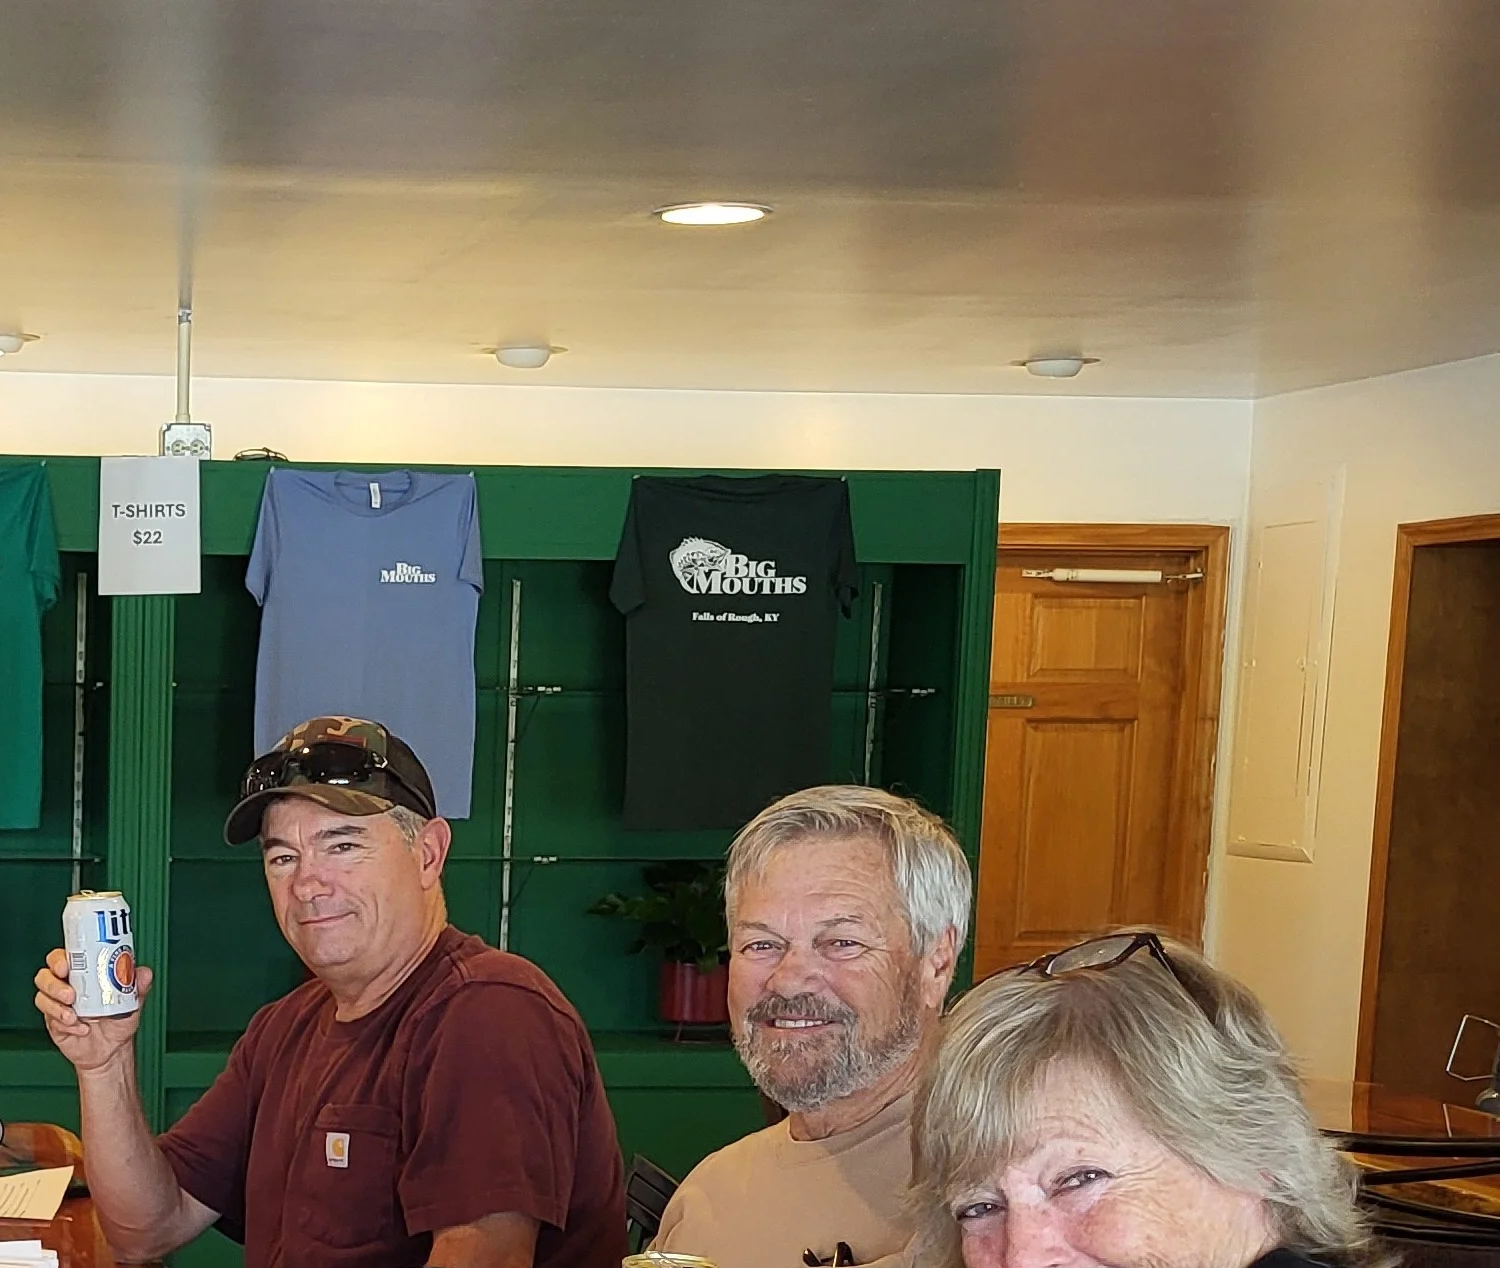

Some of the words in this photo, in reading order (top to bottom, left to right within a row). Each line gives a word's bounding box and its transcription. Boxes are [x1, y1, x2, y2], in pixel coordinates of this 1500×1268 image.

[111, 503, 186, 519] T-SHIRTS
[132, 529, 163, 546] $22
[691, 611, 715, 622] Falls
[716, 612, 728, 622] of
[727, 612, 763, 624] Rough,
[764, 613, 781, 623] KY
